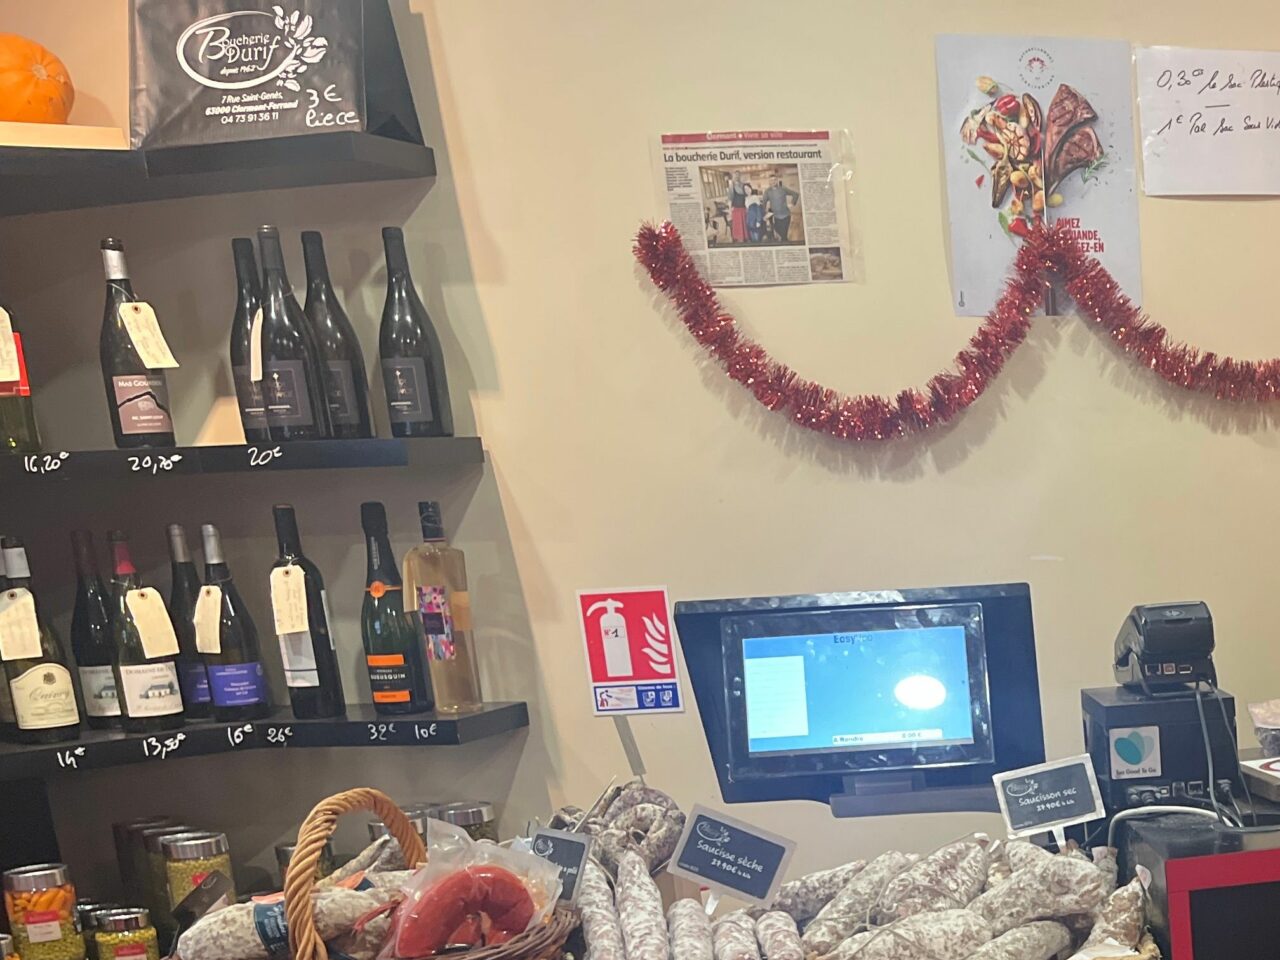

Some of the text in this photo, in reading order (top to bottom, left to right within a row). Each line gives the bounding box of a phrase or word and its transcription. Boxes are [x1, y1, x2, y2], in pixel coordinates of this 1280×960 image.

[226, 94, 240, 103] Rue
[220, 112, 279, 124] 04 73 91 36 11
[663, 149, 822, 163] La boucherie Durif, version restaurant
[1018, 791, 1061, 807] Saucisson
[696, 839, 764, 873] Saucisse sèche
